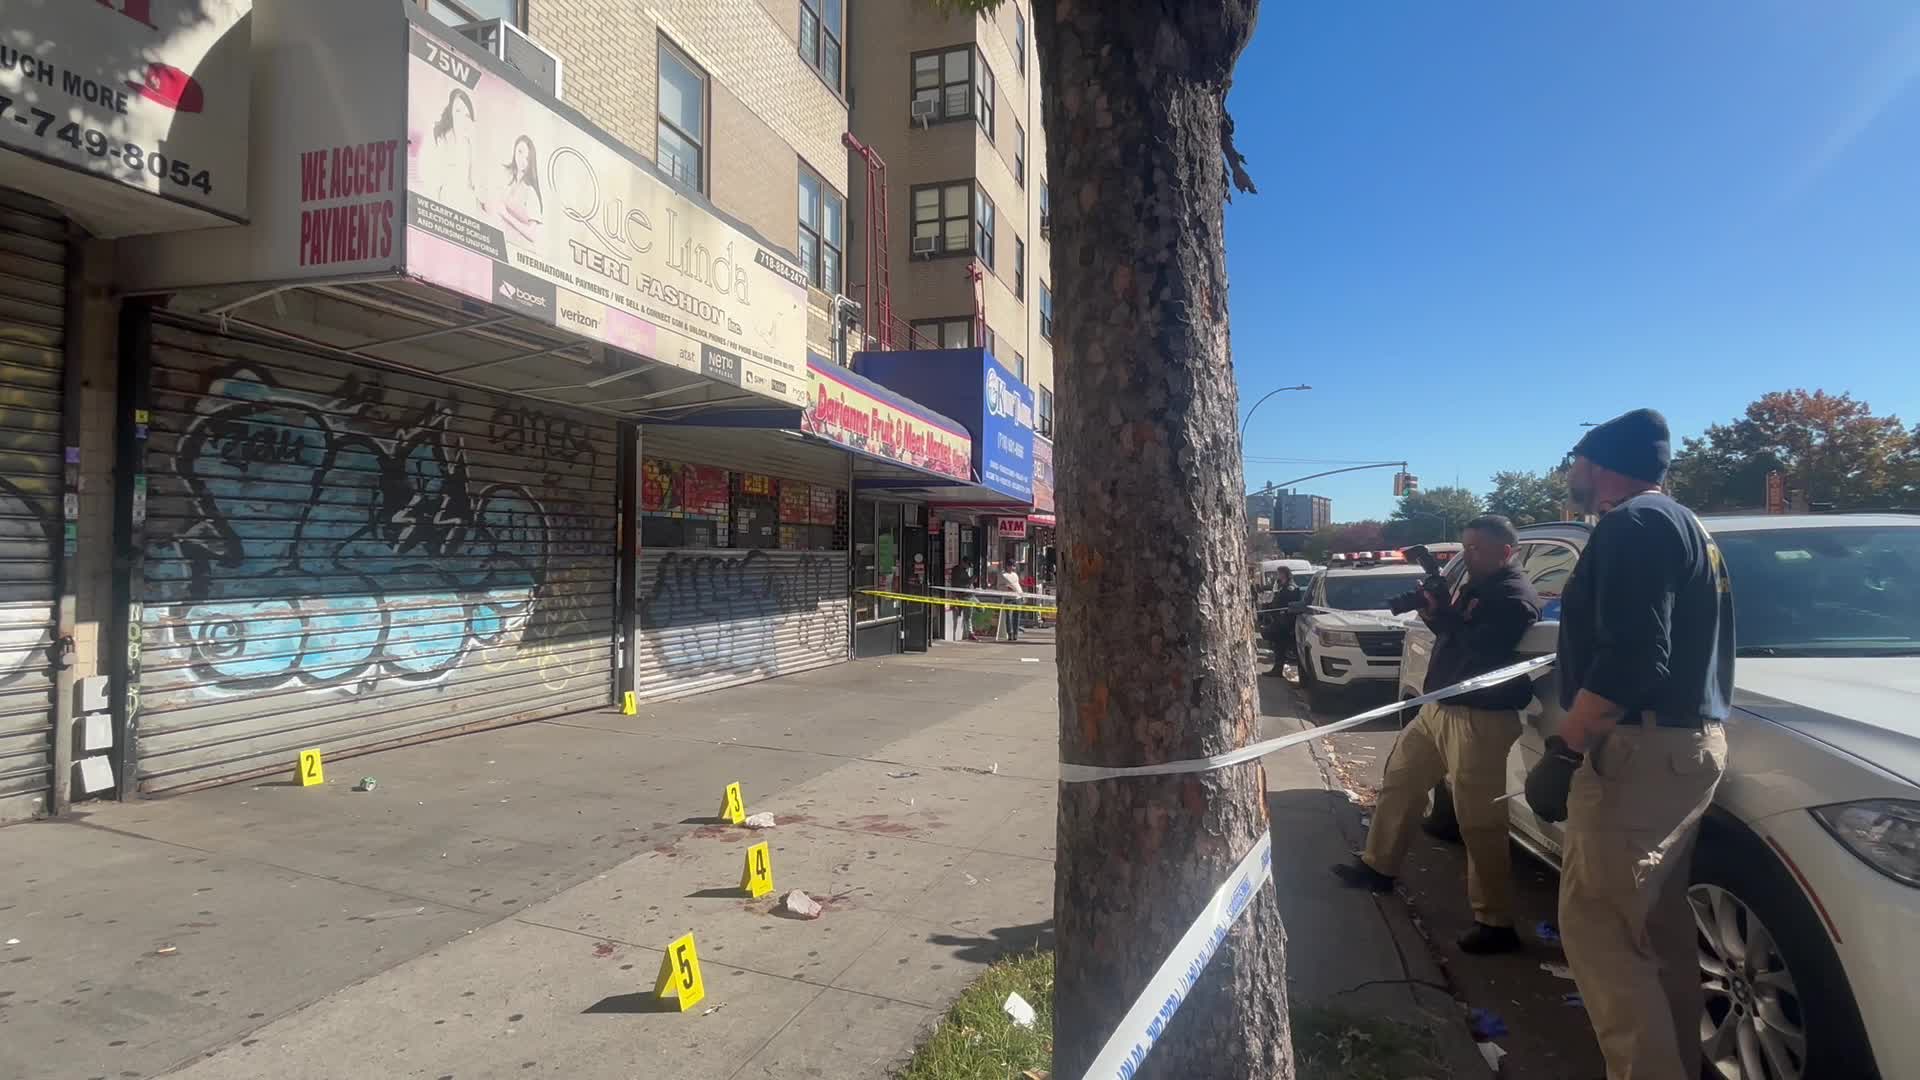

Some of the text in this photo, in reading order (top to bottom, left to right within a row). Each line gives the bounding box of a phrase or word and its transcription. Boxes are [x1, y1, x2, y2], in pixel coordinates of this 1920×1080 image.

[0, 45, 128, 115] UCH MORE
[424, 42, 470, 83] 75W
[301, 140, 398, 202] WE ACCEPT
[300, 200, 394, 266] PAYMENTS
[416, 207, 455, 229] SELECTION
[430, 203, 454, 218] CARRY
[460, 216, 480, 230] LARGE
[547, 146, 750, 305] Que Linda
[417, 217, 499, 256] AND NURSING UNIFORMS
[516, 252, 574, 285] INTERNATIONAL
[575, 277, 610, 300] PAYMENTS
[615, 292, 626, 304] WE
[626, 298, 639, 311] SELL
[646, 306, 671, 324] CONNECT
[516, 287, 546, 307] boost
[568, 239, 630, 286] TERI
[636, 272, 726, 325] FASHION
[560, 307, 598, 329] verizon
[1000, 520, 1025, 532] ATM
[305, 754, 317, 778] 2
[731, 787, 741, 813] 3
[756, 849, 767, 881] 4
[676, 944, 693, 990] 5
